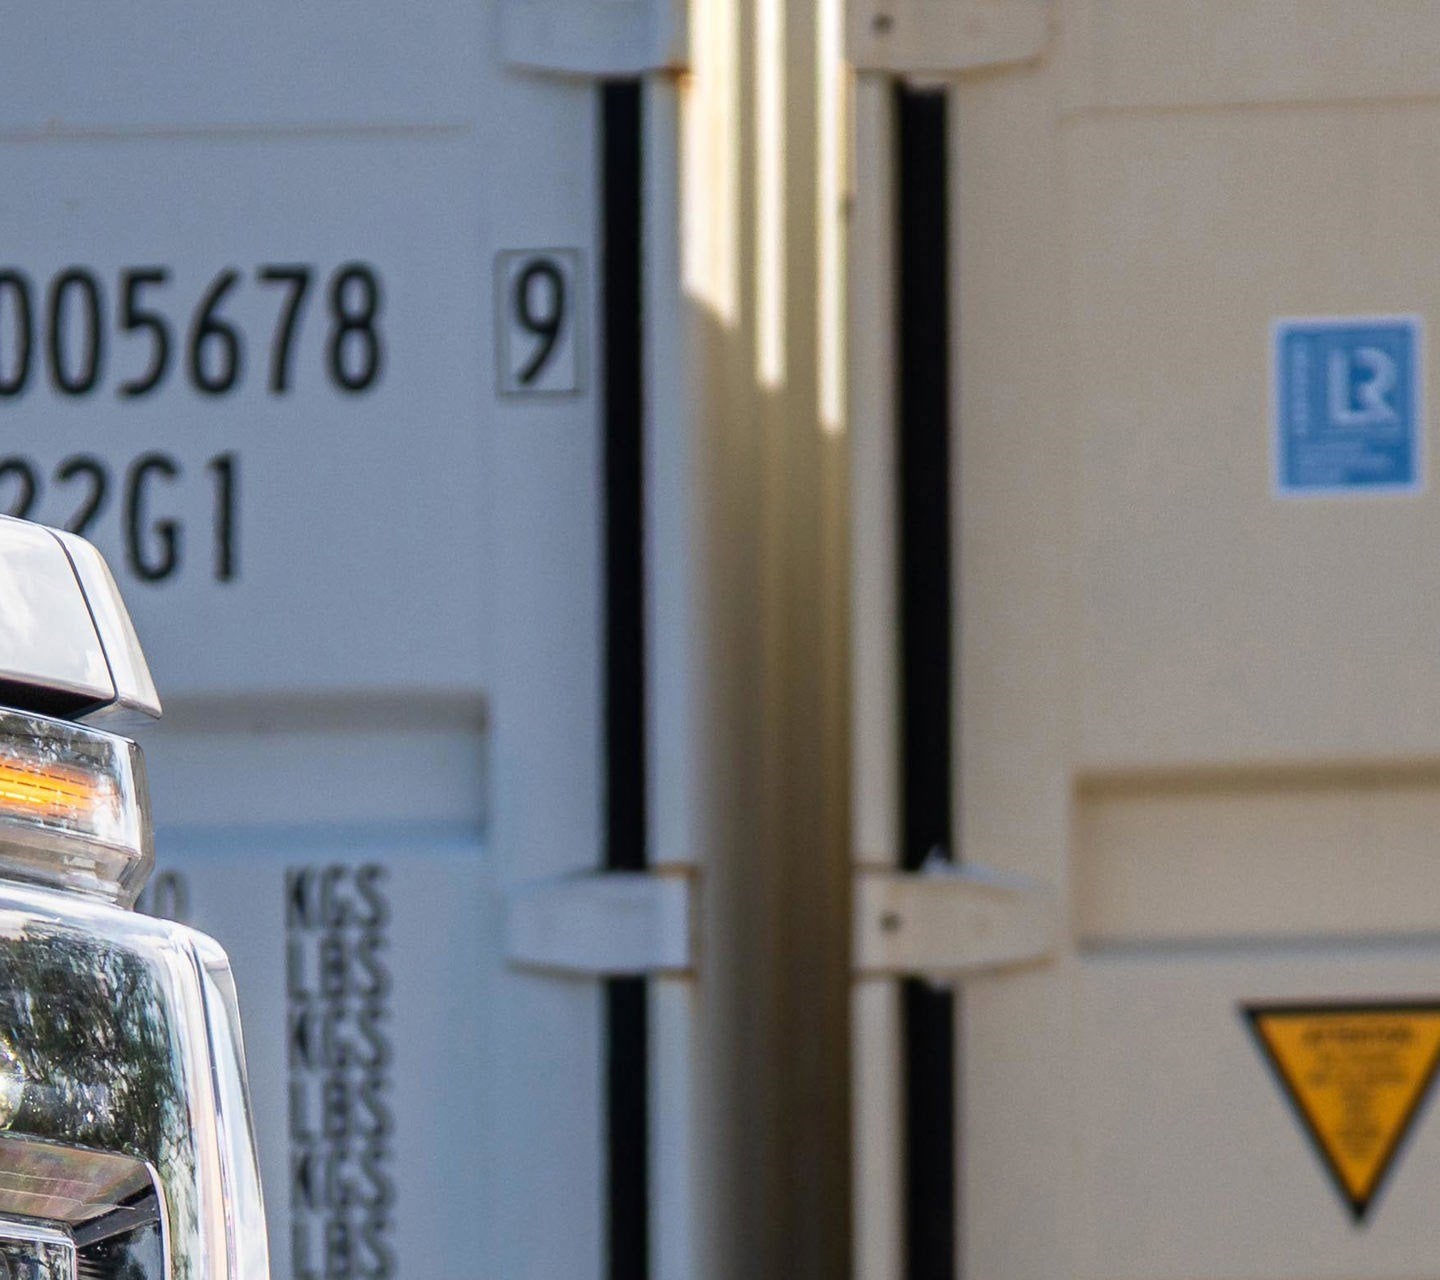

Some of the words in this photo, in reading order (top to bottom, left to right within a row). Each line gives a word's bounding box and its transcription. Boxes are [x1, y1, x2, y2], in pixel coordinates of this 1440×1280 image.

[512, 257, 569, 387] 9
[284, 862, 393, 930] KGS
[285, 933, 394, 1001] LBS
[287, 1003, 396, 1071] KGS
[288, 1075, 397, 1142] LBS
[290, 1147, 399, 1211] KGS
